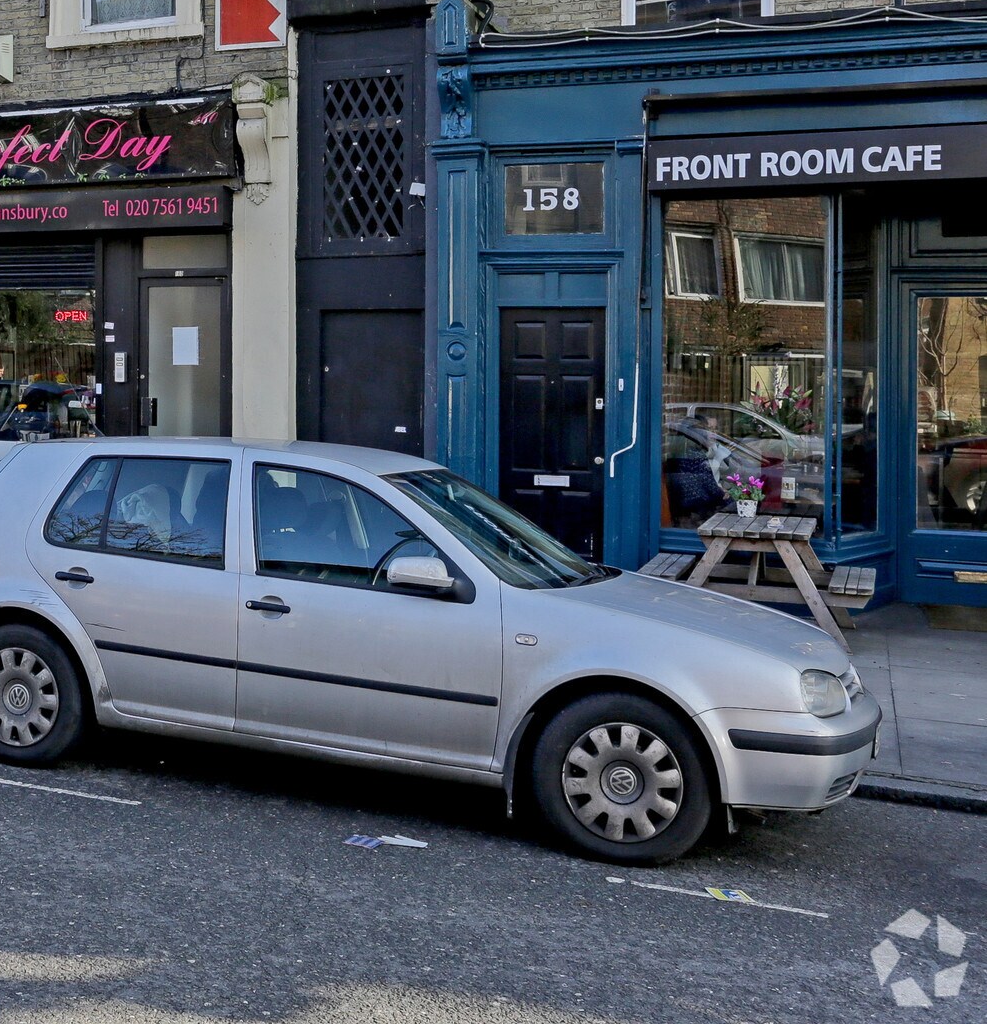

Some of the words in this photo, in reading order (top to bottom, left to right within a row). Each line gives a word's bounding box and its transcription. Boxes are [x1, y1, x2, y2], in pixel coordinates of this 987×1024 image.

[79, 118, 172, 171] Day
[656, 152, 751, 182] FRONT
[760, 148, 854, 177] ROOM
[862, 144, 942, 173] CAFE
[103, 198, 119, 217] Tel
[126, 199, 149, 217] 020
[152, 197, 182, 216] 7561
[187, 196, 218, 215] 9451
[523, 187, 579, 211] 158
[55, 310, 88, 322] OPEN
